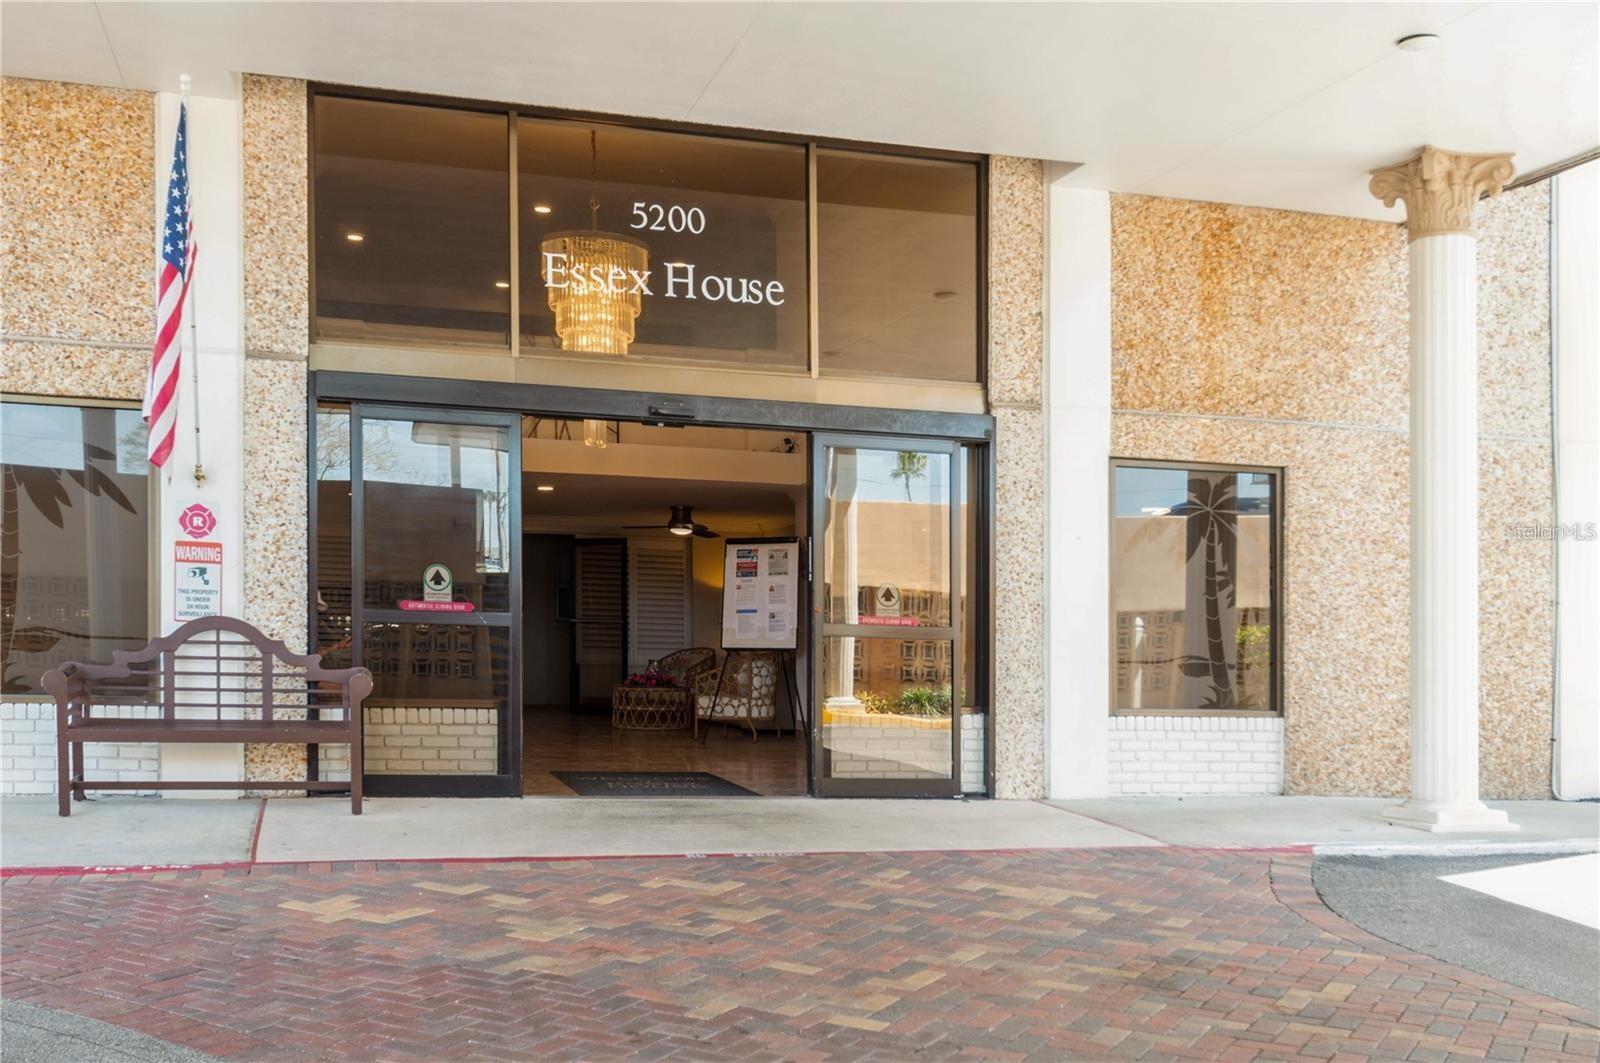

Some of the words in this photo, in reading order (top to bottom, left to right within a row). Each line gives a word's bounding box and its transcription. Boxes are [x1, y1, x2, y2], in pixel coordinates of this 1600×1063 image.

[630, 202, 706, 234] 5200
[543, 252, 654, 296] Essex
[664, 262, 785, 306] House
[193, 517, 204, 527] R
[175, 545, 221, 562] WARNING
